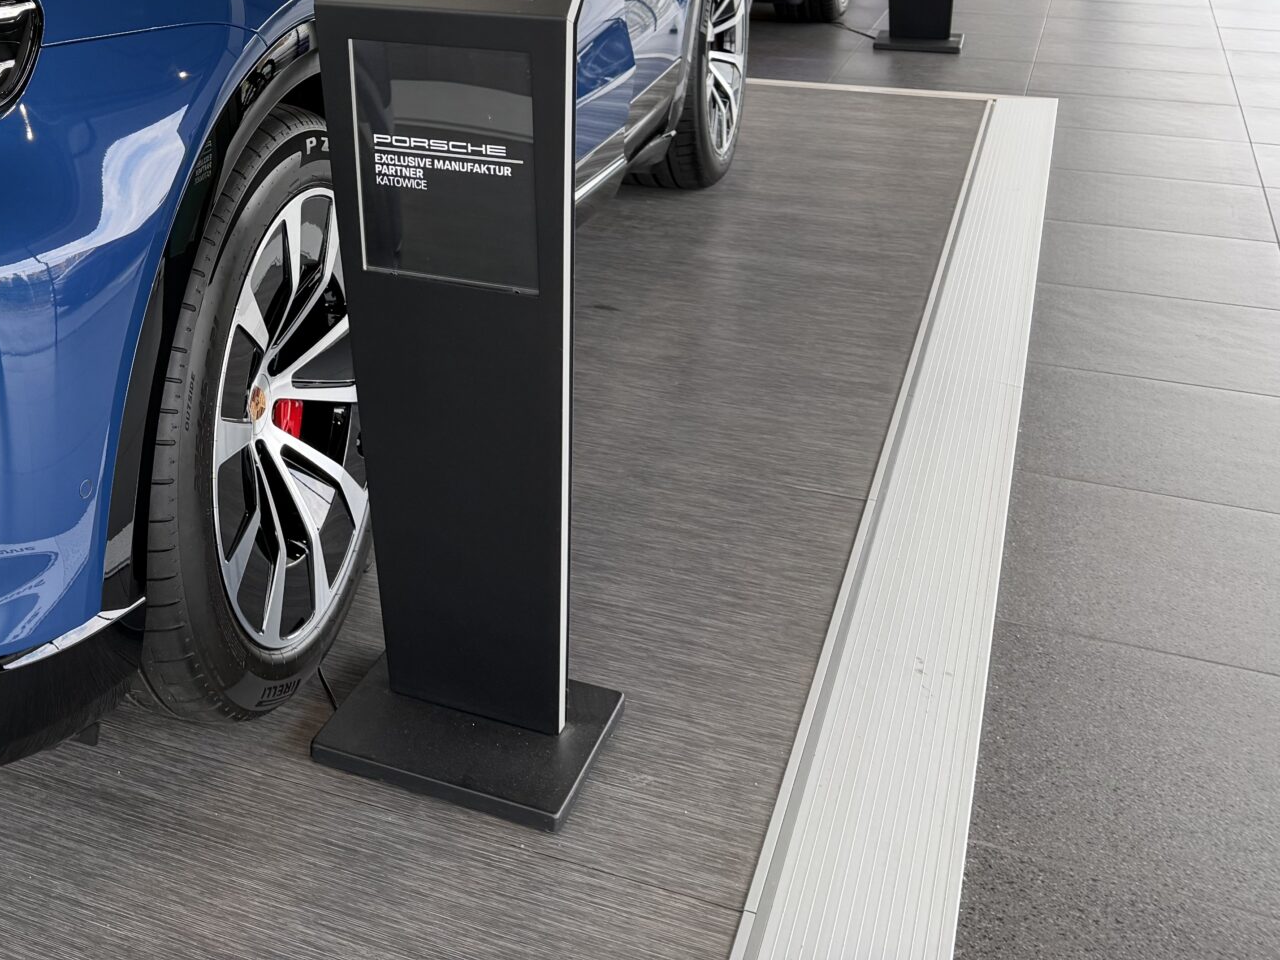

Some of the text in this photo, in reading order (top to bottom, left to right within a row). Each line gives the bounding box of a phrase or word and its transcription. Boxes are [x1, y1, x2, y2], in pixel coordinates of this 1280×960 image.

[373, 133, 507, 157] PORSCHE
[374, 153, 512, 177] EXCLUSIVE MANUFAKTUR
[375, 164, 424, 179] PARTNER
[376, 175, 428, 190] KATOWICE
